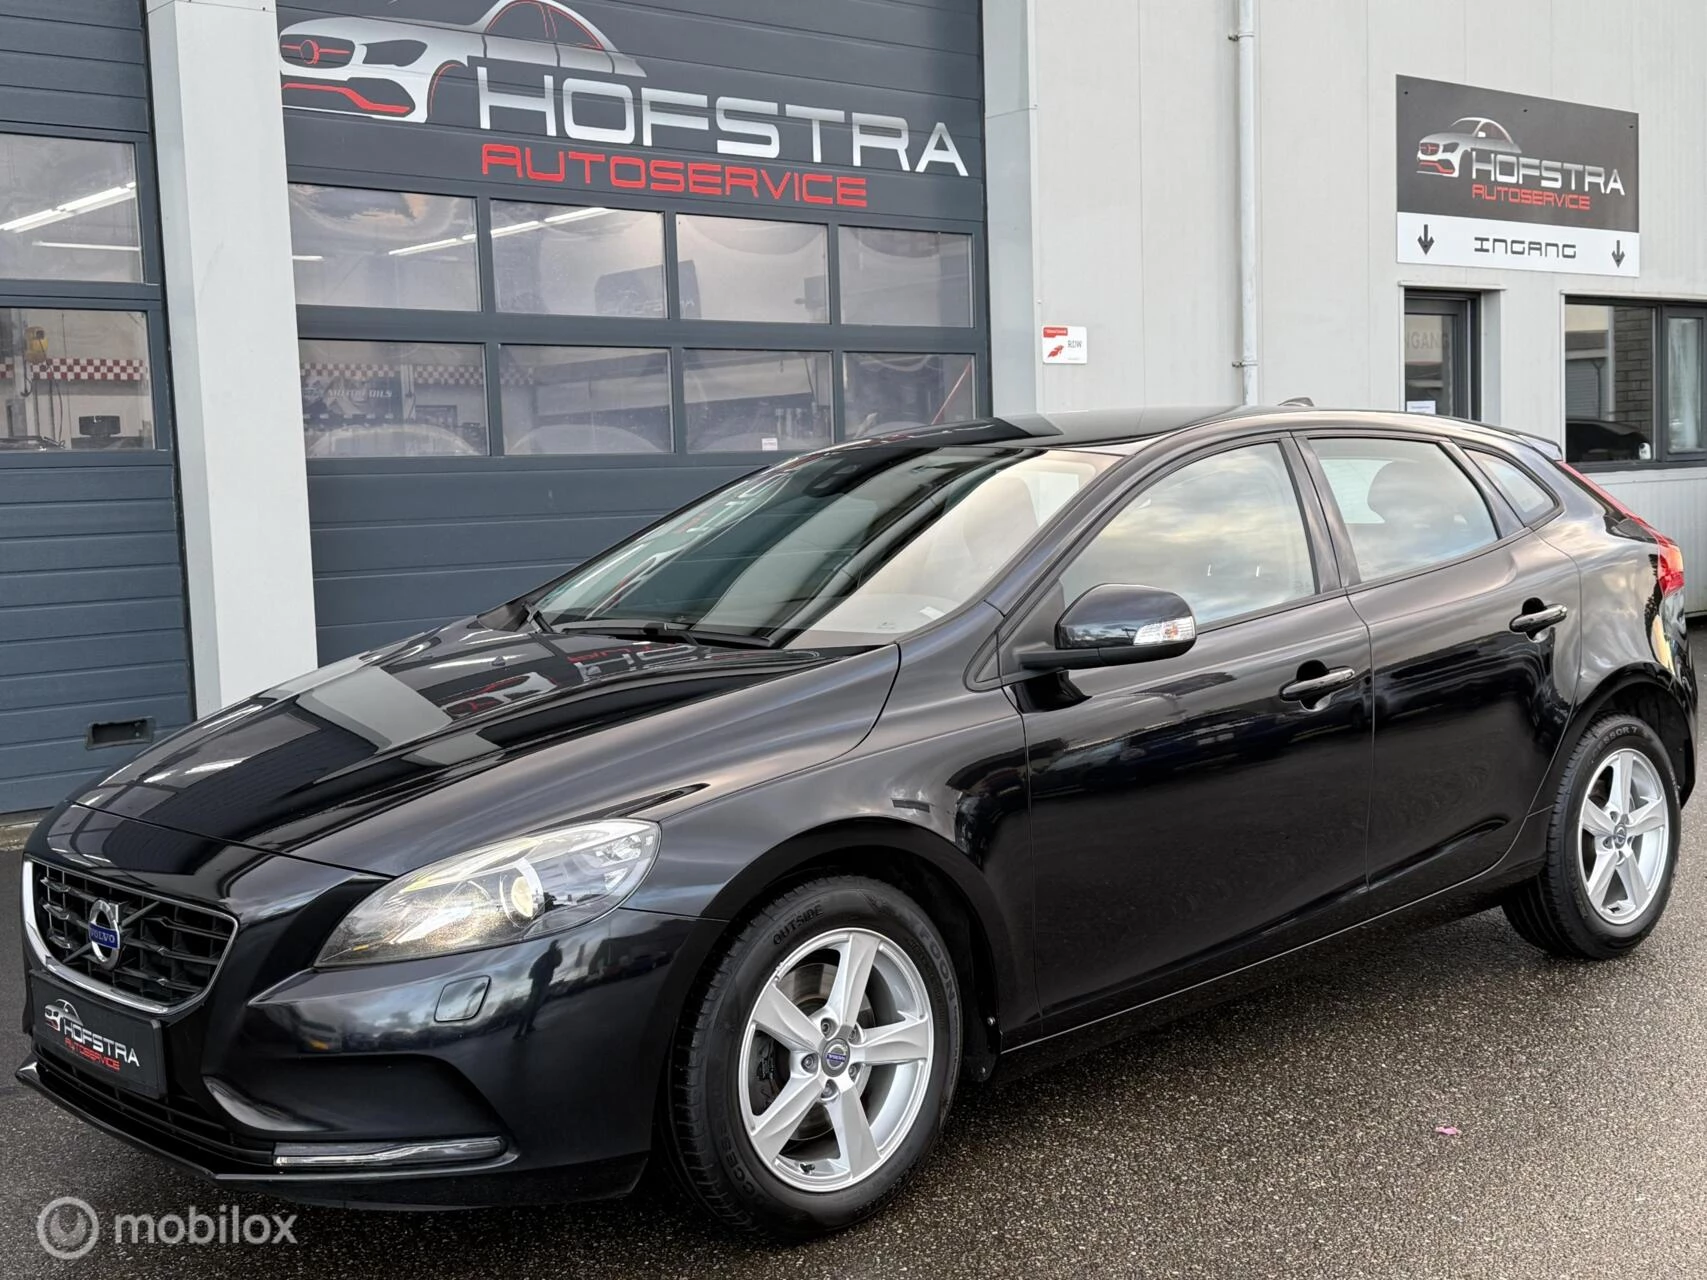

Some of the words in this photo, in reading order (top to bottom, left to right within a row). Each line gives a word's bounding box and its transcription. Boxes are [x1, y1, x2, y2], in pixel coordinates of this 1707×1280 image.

[477, 66, 969, 177] HOFSTRA
[482, 143, 867, 207] AUTOSERVICE
[1472, 151, 1625, 196] HOFSTRA
[1472, 184, 1591, 210] AUTOSERVICE
[1474, 237, 1577, 259] INGANG
[90, 928, 116, 944] VOLVO
[773, 903, 825, 946] OUTSIDE
[63, 1018, 140, 1067] HOFSTRA
